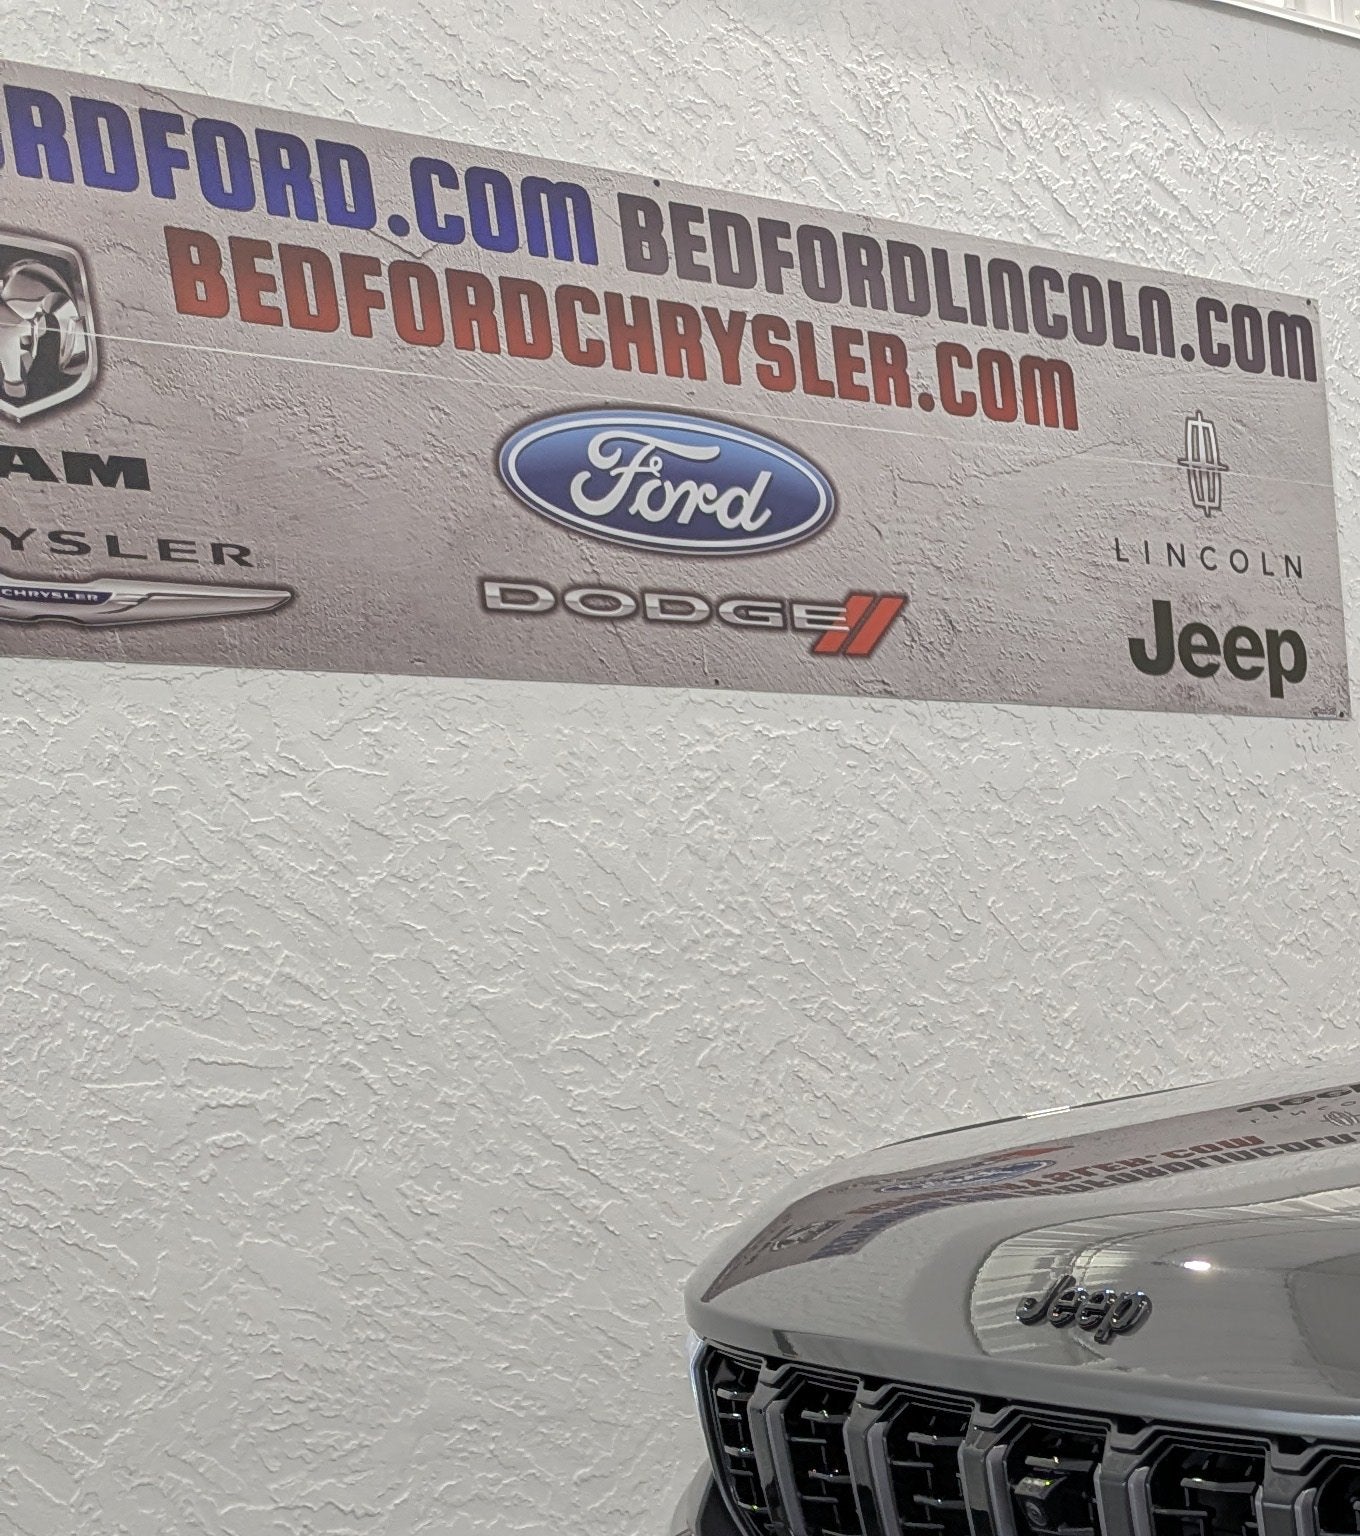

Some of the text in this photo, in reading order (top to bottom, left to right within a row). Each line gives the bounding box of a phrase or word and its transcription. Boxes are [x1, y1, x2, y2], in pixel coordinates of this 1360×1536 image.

[0, 84, 1317, 382] RDFORD.COM BEDFORDLINCOLN.COM
[164, 226, 1078, 431] BEDFORDCHRYSLER.COM
[570, 430, 772, 532] Ford
[1, 588, 98, 602] CHRYSLER
[1114, 537, 1303, 579] LINCOLN
[482, 579, 851, 632] DODGE
[1128, 600, 1308, 698] Jeep
[1015, 1274, 1152, 1344] Jeep
